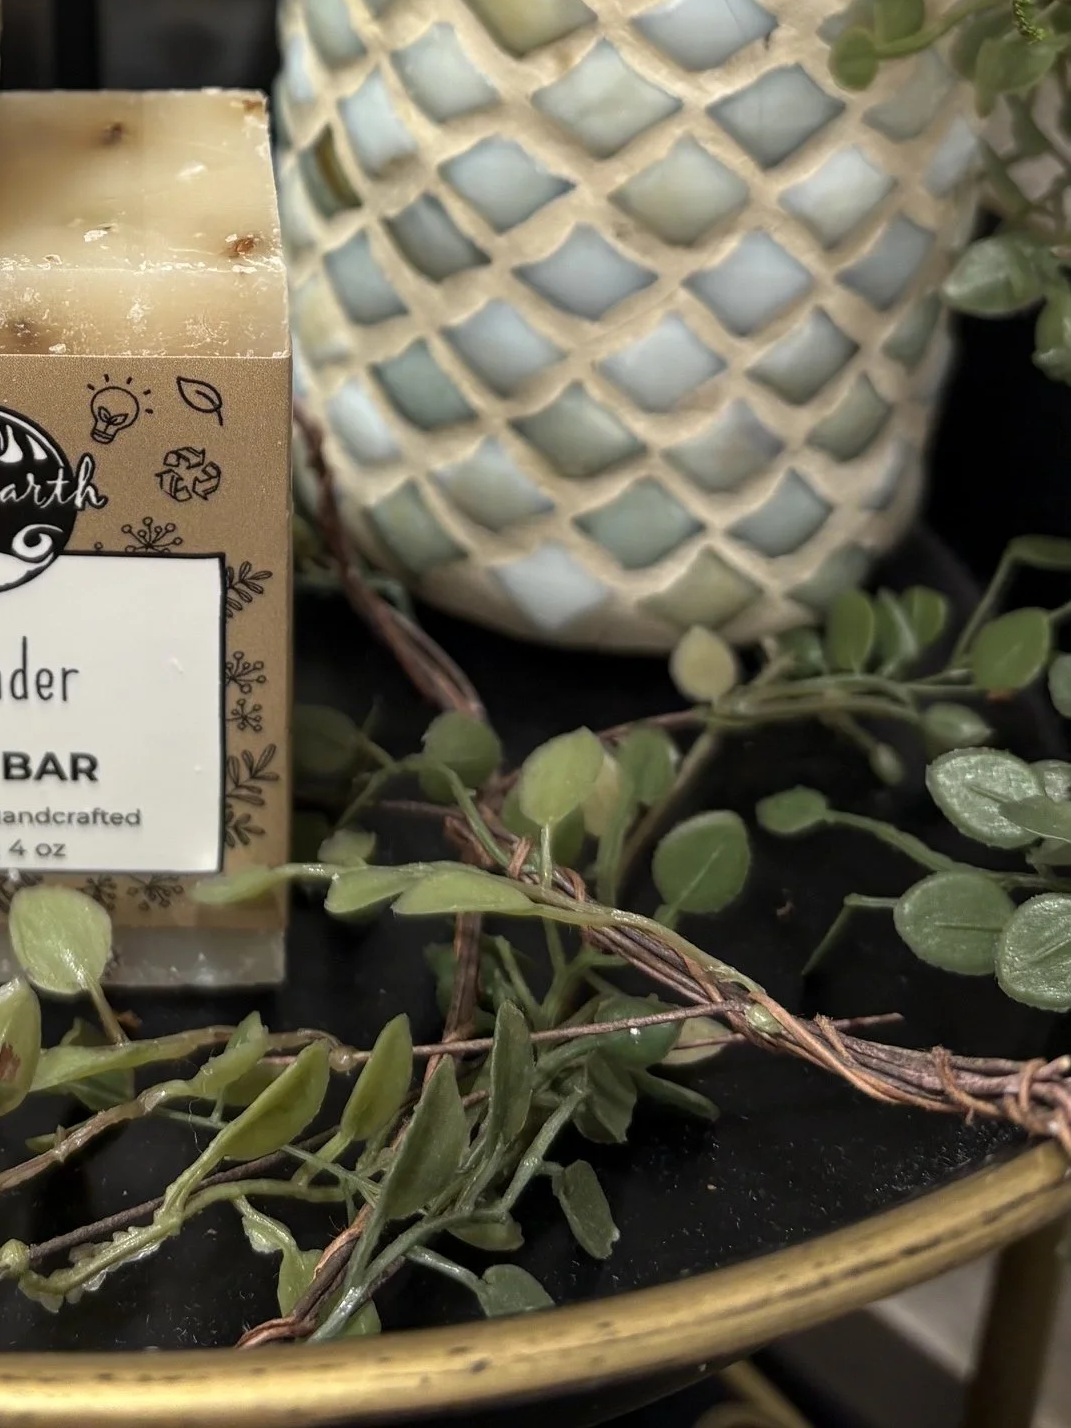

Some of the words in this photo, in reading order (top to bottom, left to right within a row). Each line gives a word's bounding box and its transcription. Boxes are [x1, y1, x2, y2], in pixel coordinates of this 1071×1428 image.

[0, 750, 100, 785] BAR
[7, 838, 28, 859] 4
[33, 842, 67, 860] oz
